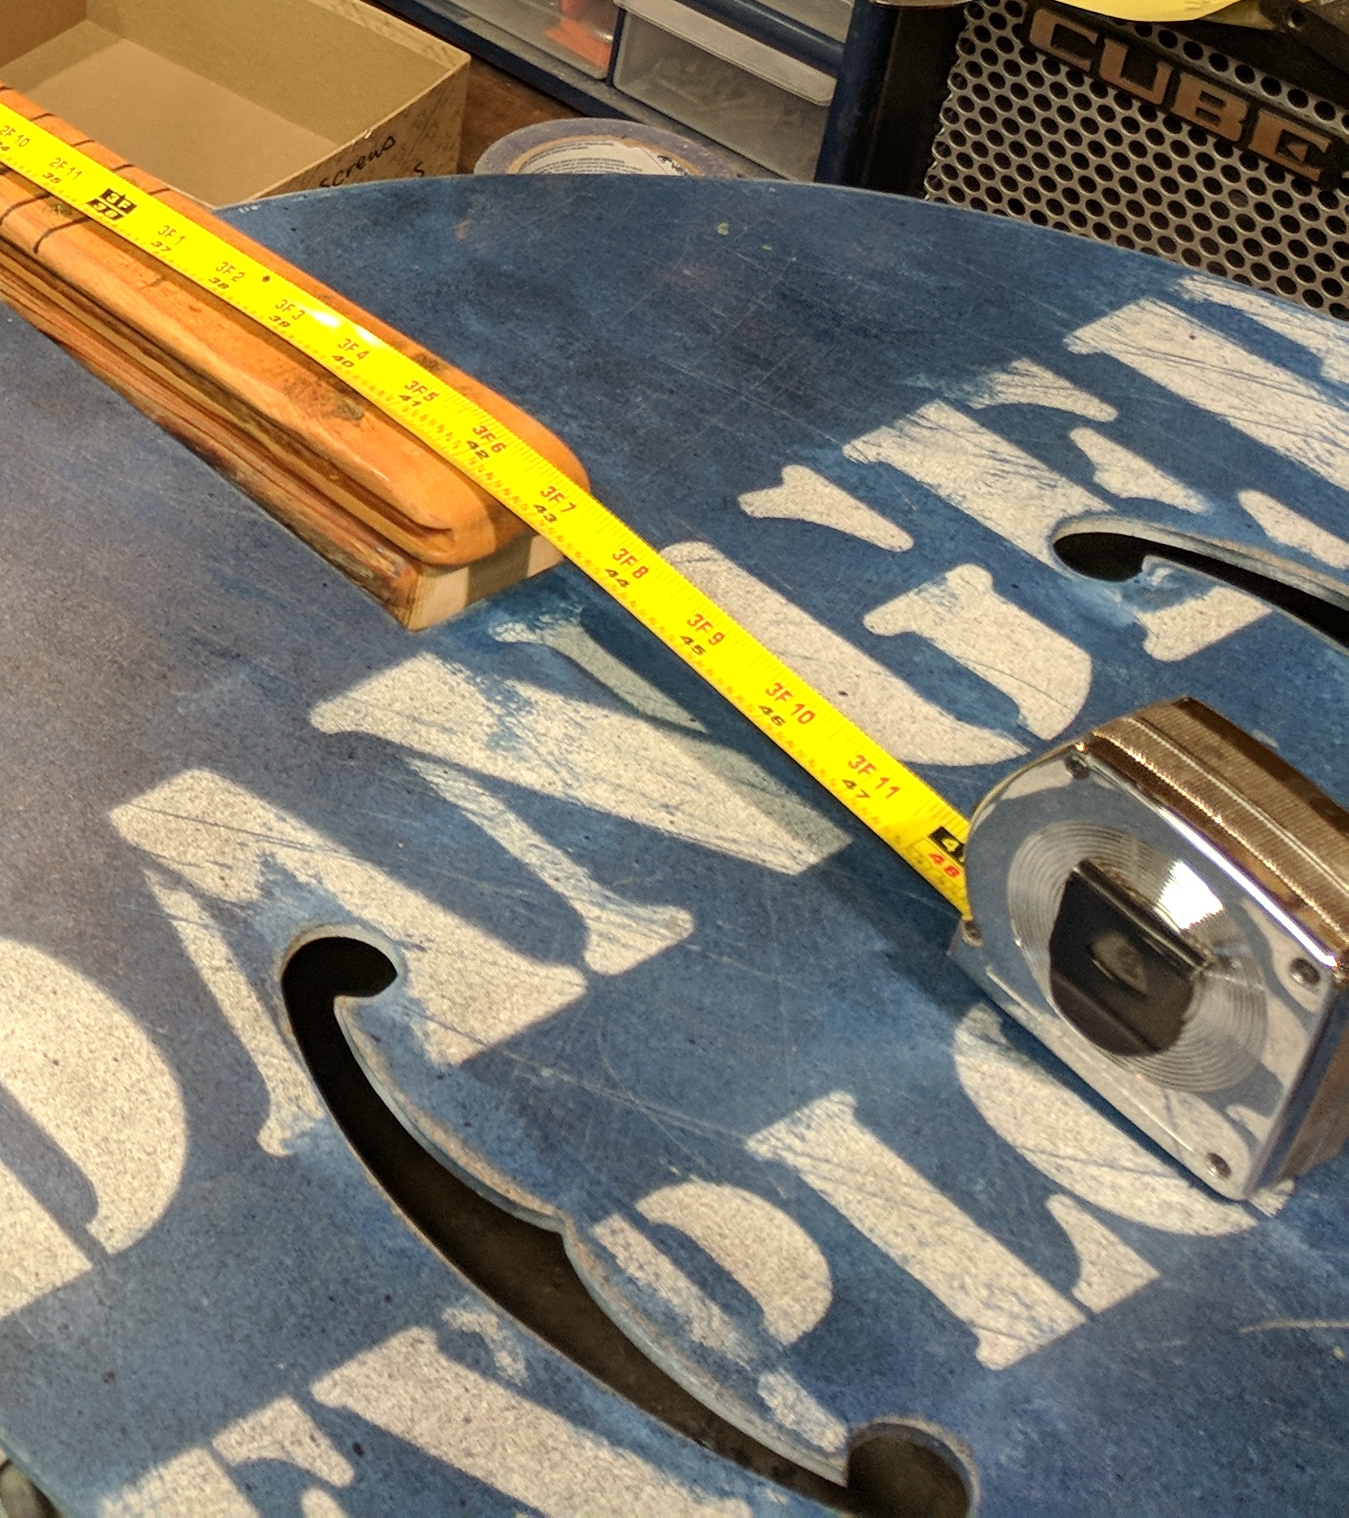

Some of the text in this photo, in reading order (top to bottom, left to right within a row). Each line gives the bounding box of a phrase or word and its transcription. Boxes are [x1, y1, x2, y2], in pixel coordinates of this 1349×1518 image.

[1029, 8, 1332, 182] CUBE
[42, 172, 62, 185] 35
[105, 190, 133, 212] 3F
[150, 240, 173, 253] 37
[208, 277, 230, 290] 38
[268, 315, 291, 329] 39
[331, 354, 355, 369] 40
[399, 394, 421, 408] 41
[465, 439, 490, 460] 42
[532, 502, 558, 524] 43
[604, 567, 631, 589] 44
[679, 634, 707, 657] 45
[757, 704, 786, 728] 46
[841, 778, 871, 801] 47
[928, 852, 962, 879] 48
